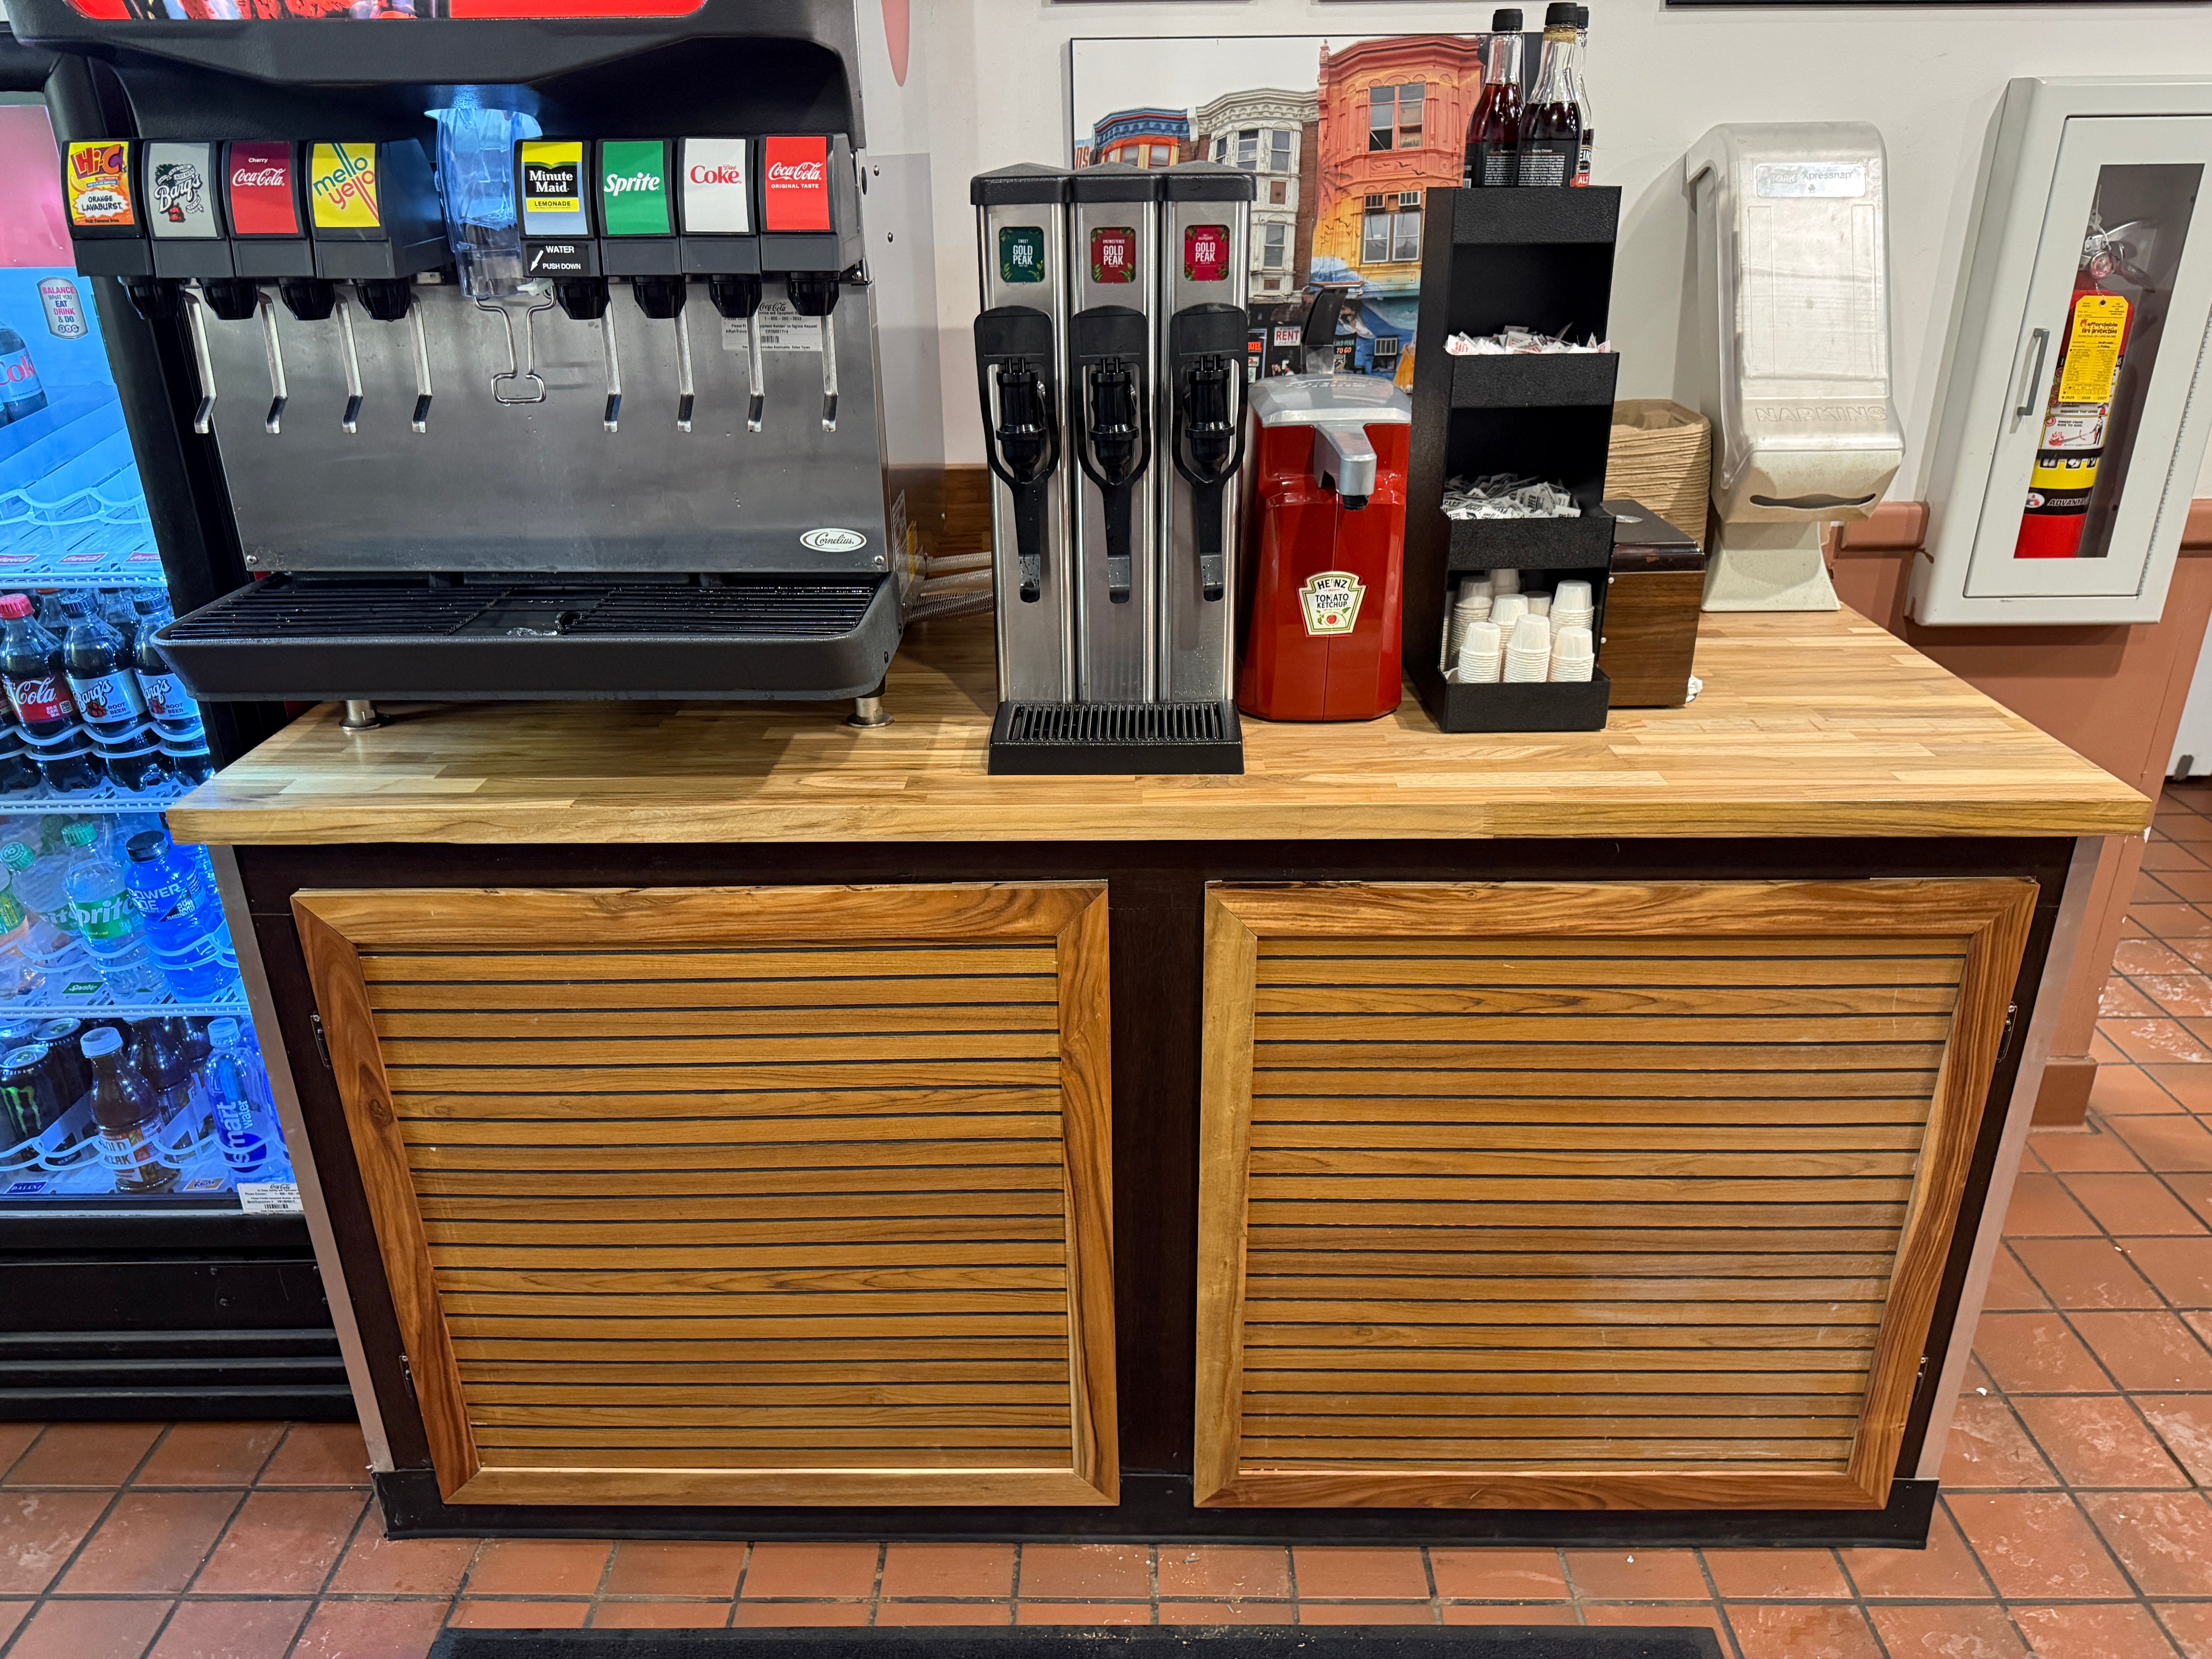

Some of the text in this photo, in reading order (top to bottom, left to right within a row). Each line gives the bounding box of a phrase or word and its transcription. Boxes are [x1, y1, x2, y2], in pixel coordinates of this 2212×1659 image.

[74, 144, 121, 174] Hi-C
[1579, 150, 1591, 163] EINZ
[232, 168, 286, 186] Coca-Cola
[313, 150, 368, 196] mello
[529, 170, 573, 181] Minute
[690, 165, 740, 184] Coke
[768, 162, 823, 180] Coca-Cola
[1803, 171, 1853, 180] Xpressnap
[604, 172, 660, 196] Sprite
[1578, 176, 1589, 184] ALT
[328, 171, 376, 214] yello
[536, 181, 568, 193] Maid
[154, 173, 203, 214] Barq's
[1013, 245, 1033, 255] GOLD
[1103, 245, 1123, 255] GOLD
[1196, 242, 1215, 252] GOLD
[1013, 255, 1033, 265] PEAK
[1103, 255, 1124, 265] PEAK
[1195, 252, 1215, 262] PEAK
[1276, 331, 1299, 341] RENT
[1755, 407, 1887, 422] NAPKINS
[1315, 594, 1348, 603] TOMATO
[16, 676, 56, 705] Cola
[73, 679, 114, 714] Barq's
[143, 679, 172, 705] arq's
[238, 1100, 253, 1129] water
[103, 1142, 126, 1151] OLD
[105, 1155, 131, 1165] EAK
